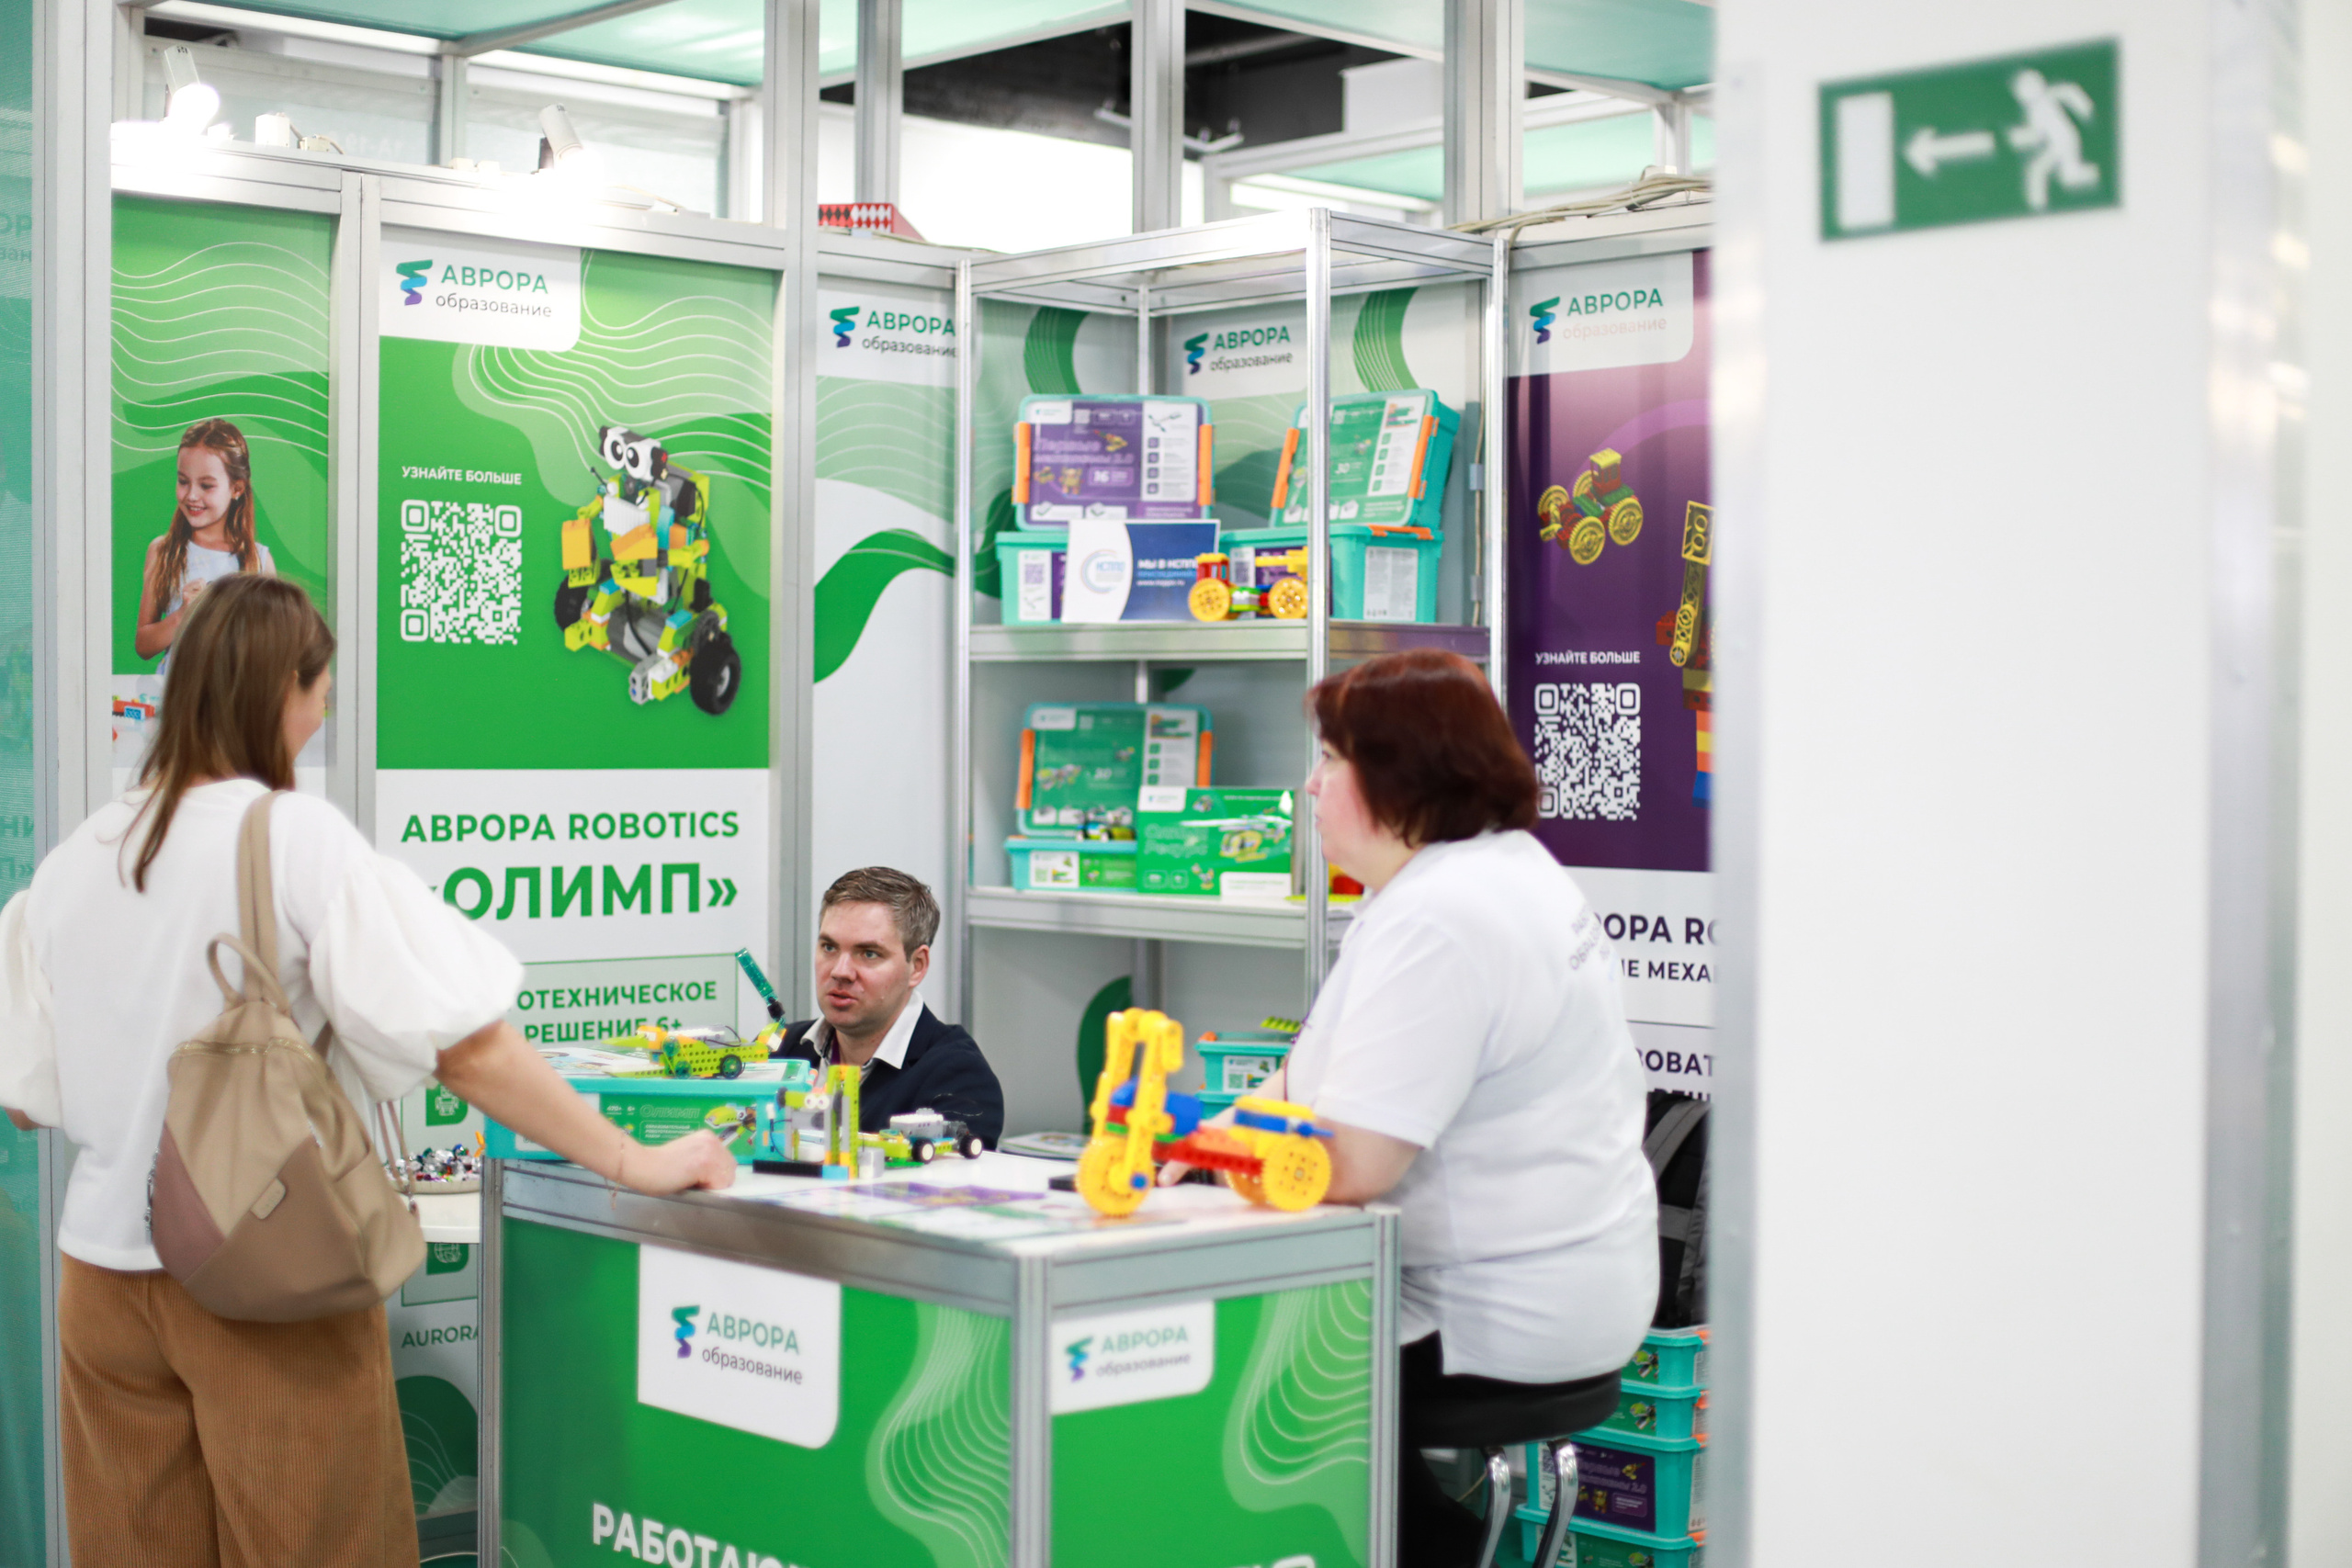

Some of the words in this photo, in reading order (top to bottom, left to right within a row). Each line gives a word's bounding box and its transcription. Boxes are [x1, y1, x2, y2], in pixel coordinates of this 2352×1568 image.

[441, 265, 548, 294] АВРОРА
[435, 293, 551, 317] образование
[1567, 288, 1664, 316] АВРОРА
[866, 310, 956, 336] АВРОРА
[1563, 318, 1667, 340] образование
[862, 335, 957, 357] образование
[1213, 326, 1291, 351] АВРОРА
[1209, 353, 1293, 372] образование
[401, 466, 463, 481] УЗНАЙТЕ
[466, 469, 522, 485] БОЛЬШЕ
[1535, 649, 1588, 665] УЗНАЙТЕ
[1589, 650, 1641, 664] БОЛЬШЕ
[401, 813, 556, 842] АВРОРА
[569, 811, 739, 840] ROBOTICS
[430, 863, 738, 920] ОЛИМП»
[1594, 912, 1672, 943] ОРА
[1648, 961, 1713, 983] МЕХА
[516, 980, 717, 1010] ОТЕХНИЧЕСКОЕ
[1636, 1047, 1715, 1077] ОВАТ
[707, 1312, 799, 1354] АВРОРА
[1102, 1325, 1188, 1353] АВРОРА
[702, 1346, 803, 1384] образование
[1096, 1354, 1191, 1376] образование
[593, 1502, 801, 1568] РАБОТА
